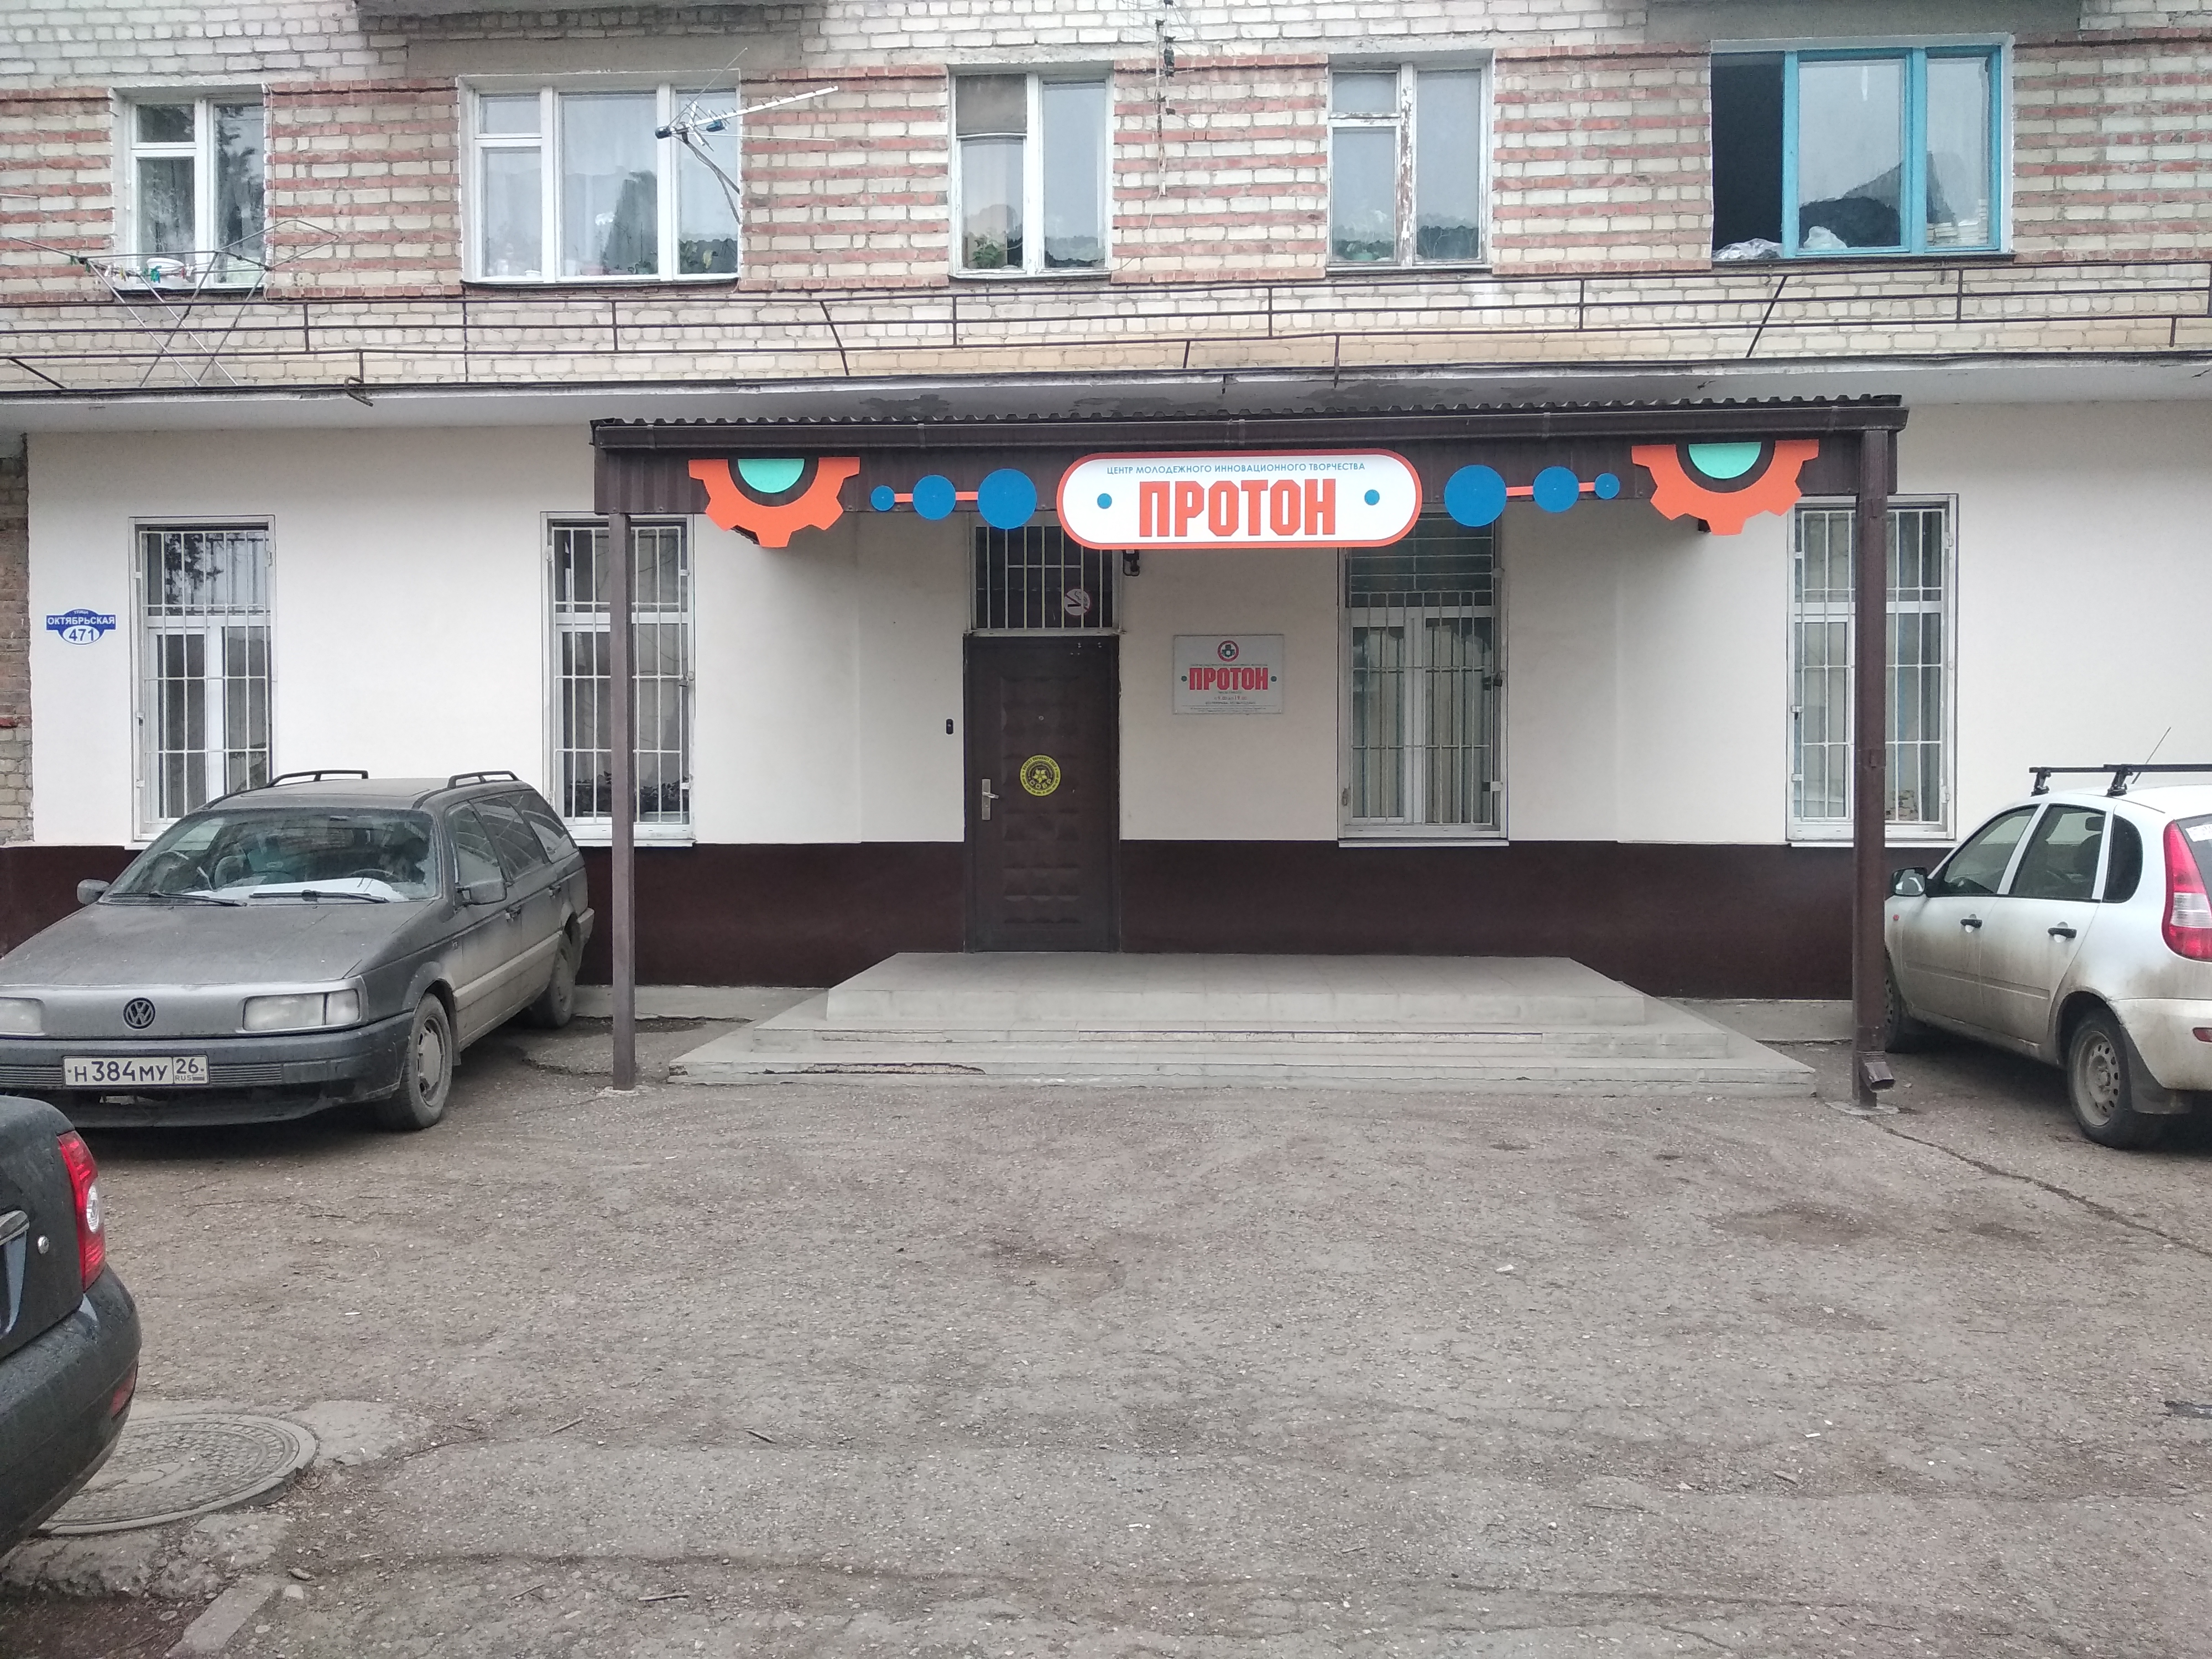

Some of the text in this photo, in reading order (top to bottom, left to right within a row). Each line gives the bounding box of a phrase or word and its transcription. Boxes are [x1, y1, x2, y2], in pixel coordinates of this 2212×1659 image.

[1107, 462, 1365, 475] ЦЕНТР МОЛОДЕЖНОГО ИННОВАЦИОННОГО ТВОРЧЕСТВА
[1139, 478, 1336, 537] ПРОТОН
[48, 617, 115, 625] ОКТЯБРЬСКАЯ
[69, 628, 94, 641] 471
[1189, 667, 1269, 691] ПРОТОН
[175, 1058, 200, 1074] 26
